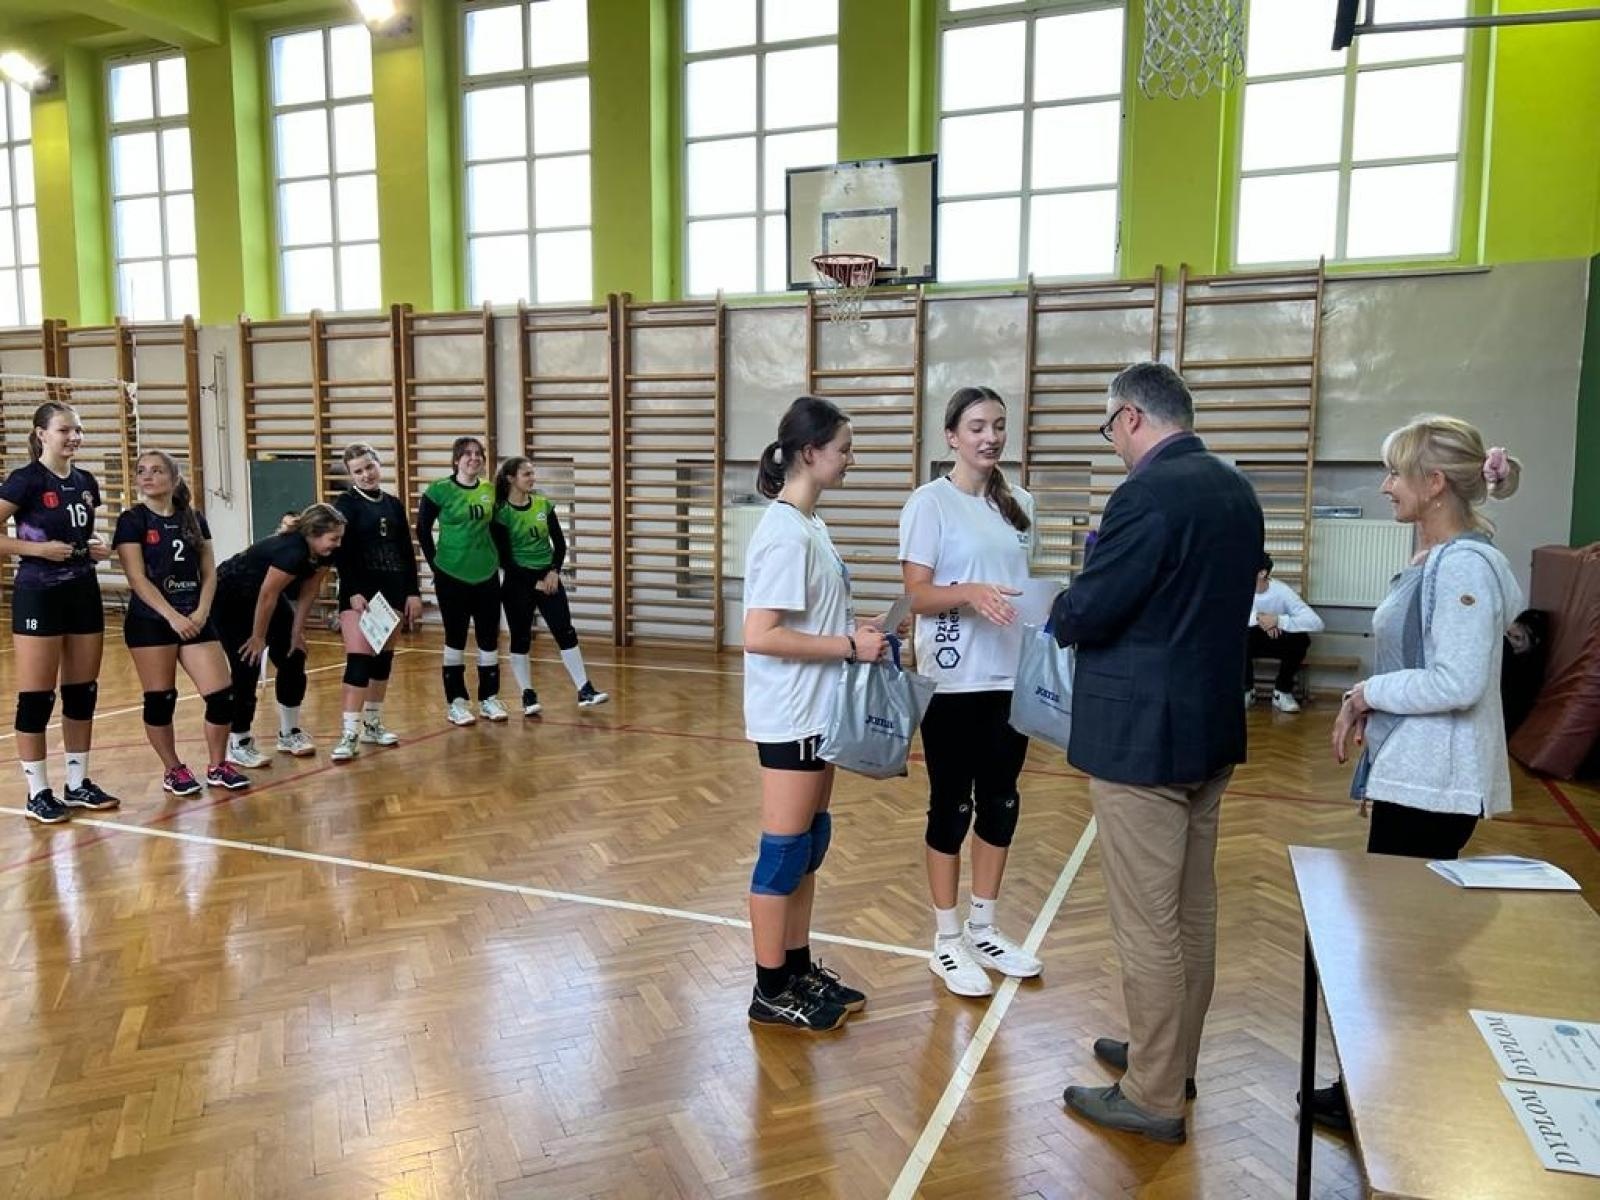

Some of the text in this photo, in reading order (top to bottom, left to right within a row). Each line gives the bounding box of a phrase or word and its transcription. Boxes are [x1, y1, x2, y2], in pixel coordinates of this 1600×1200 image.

[66, 503, 87, 528] 16
[172, 538, 185, 562] 2
[797, 738, 816, 762] 11
[1486, 1015, 1538, 1077] DYPLOM
[1516, 1086, 1581, 1167] DYPLOM
